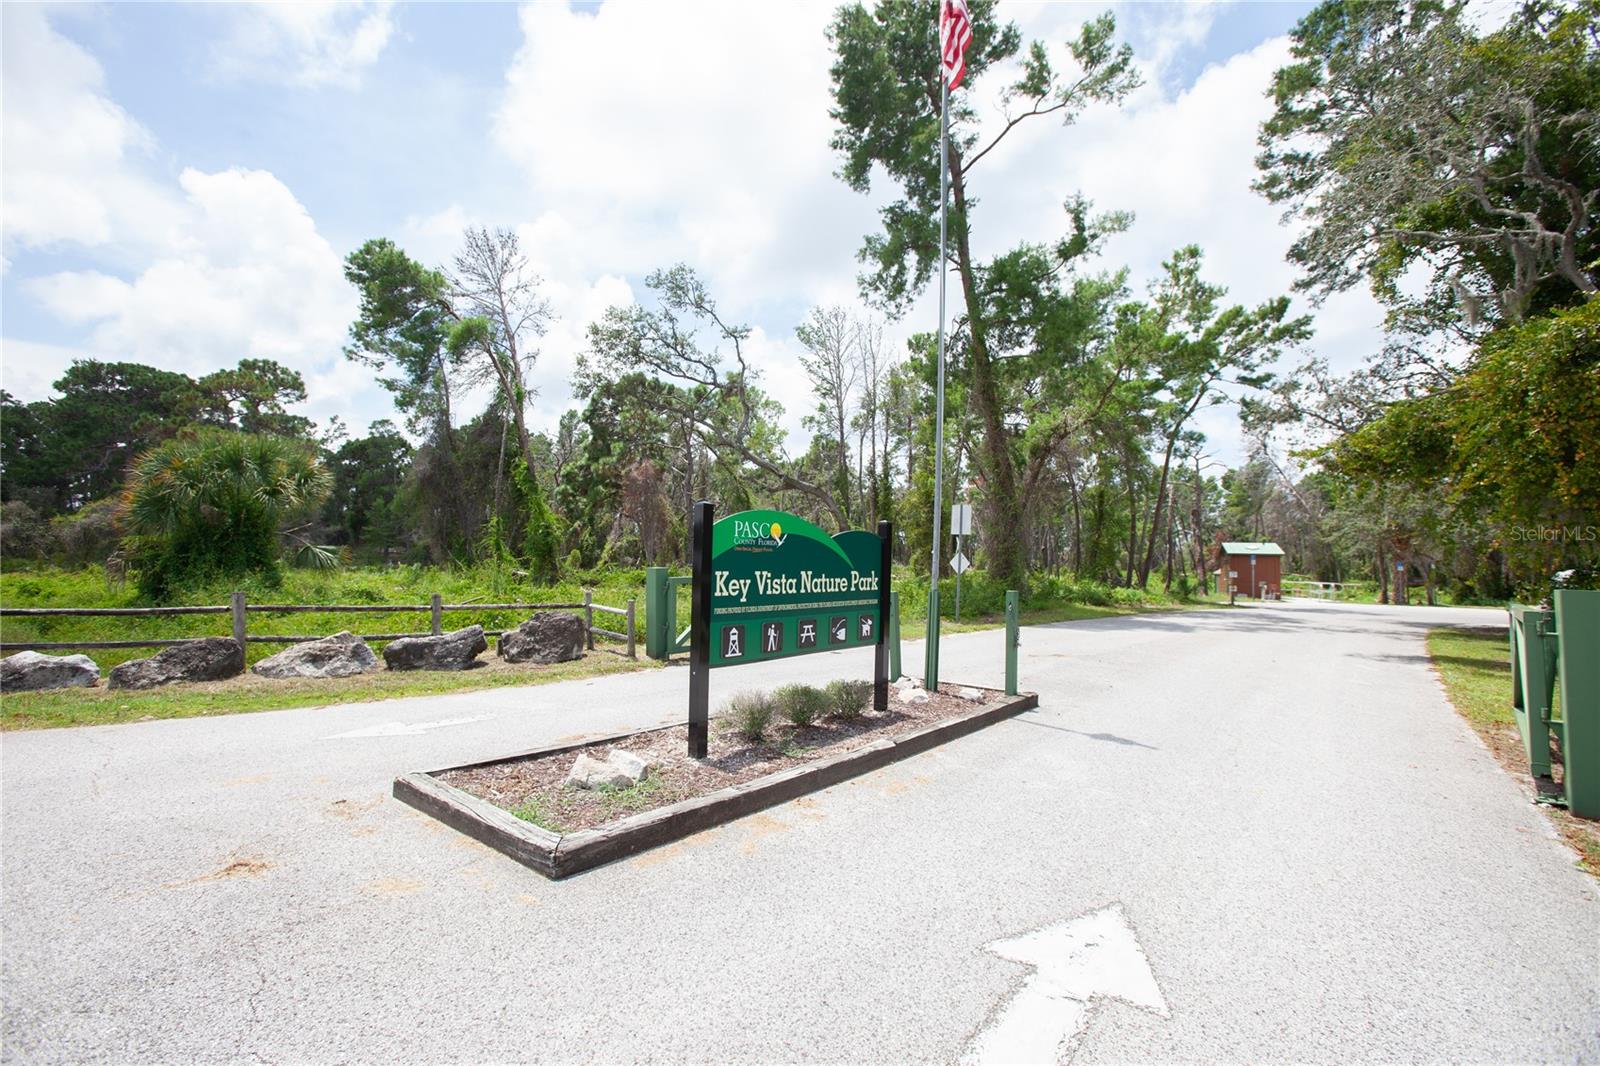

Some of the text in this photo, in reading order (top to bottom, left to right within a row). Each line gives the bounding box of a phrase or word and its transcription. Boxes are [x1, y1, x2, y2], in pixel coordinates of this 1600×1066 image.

[734, 538, 756, 546] COUNTY
[714, 570, 879, 602] Key Vista Nature Park
